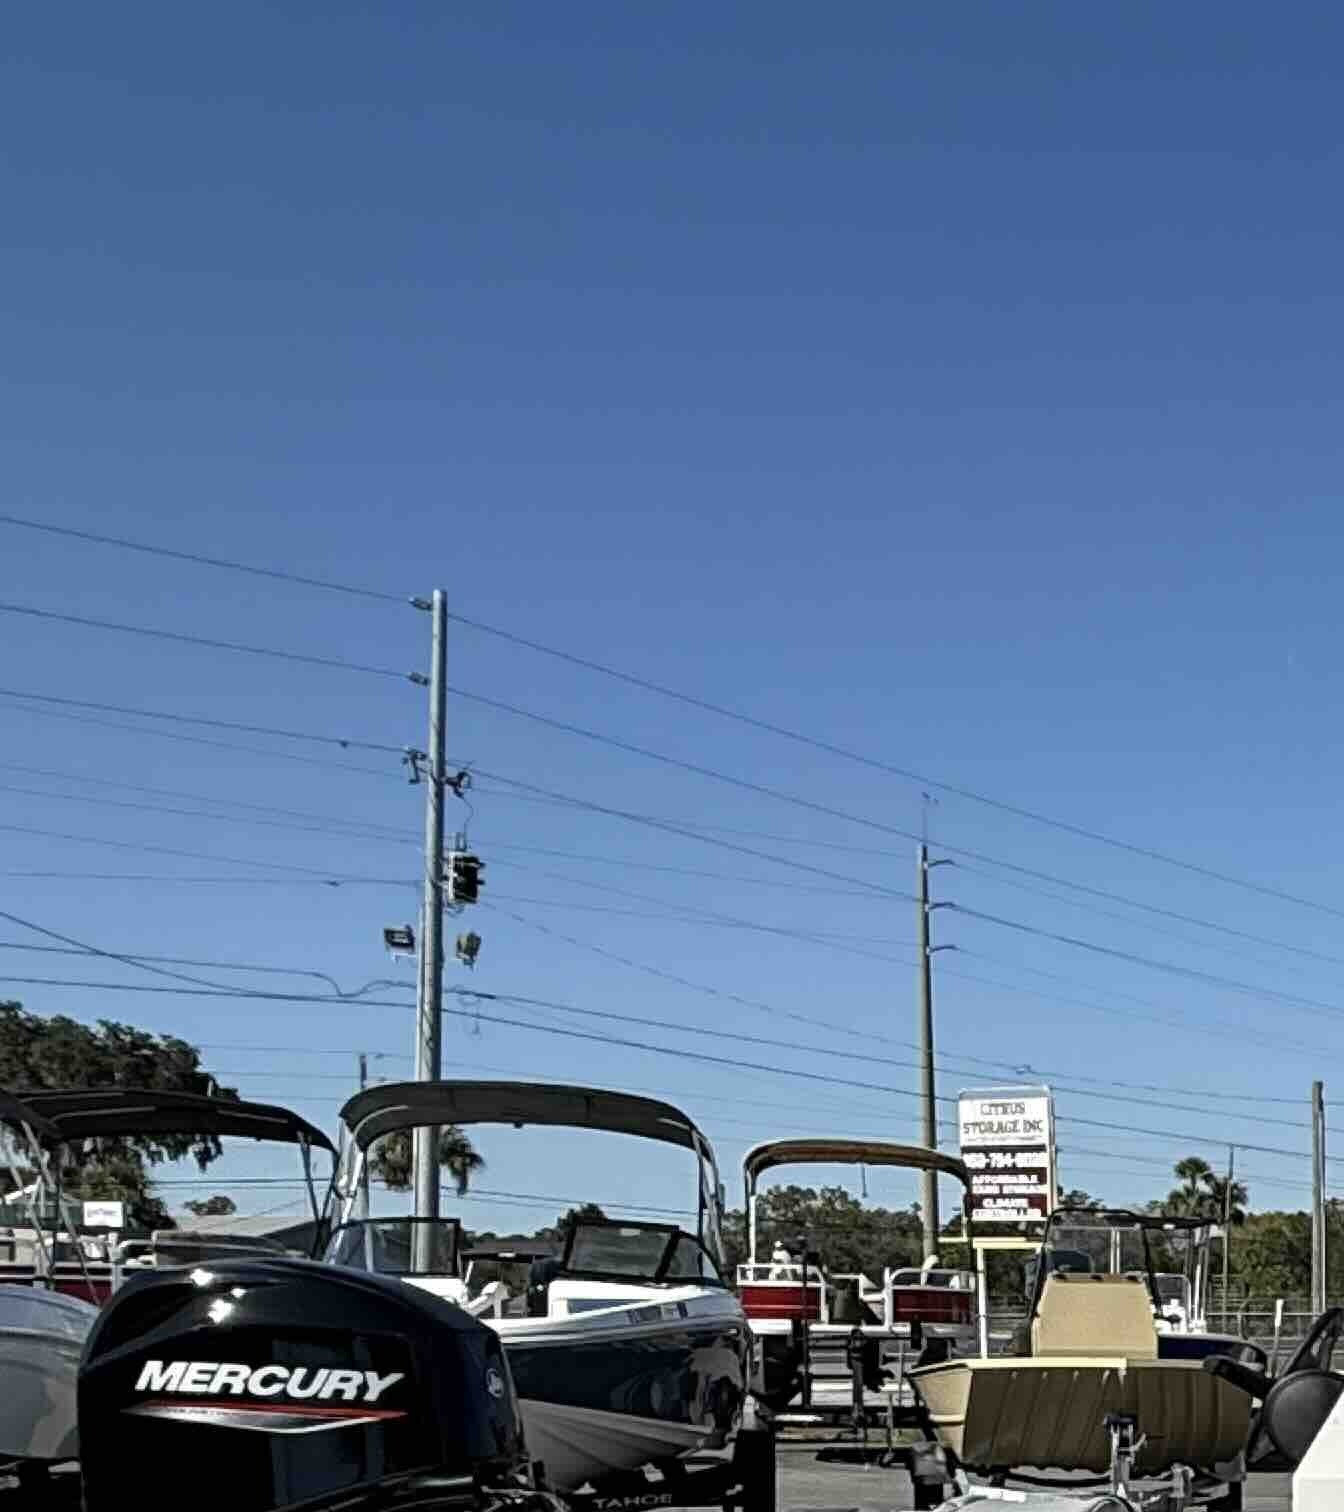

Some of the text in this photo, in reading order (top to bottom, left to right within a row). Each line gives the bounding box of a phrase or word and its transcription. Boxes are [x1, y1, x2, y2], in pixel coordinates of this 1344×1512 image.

[963, 1120, 1019, 1134] STORAGE
[135, 1360, 405, 1401] MERCURY
[592, 1493, 672, 1509] TAHOE
